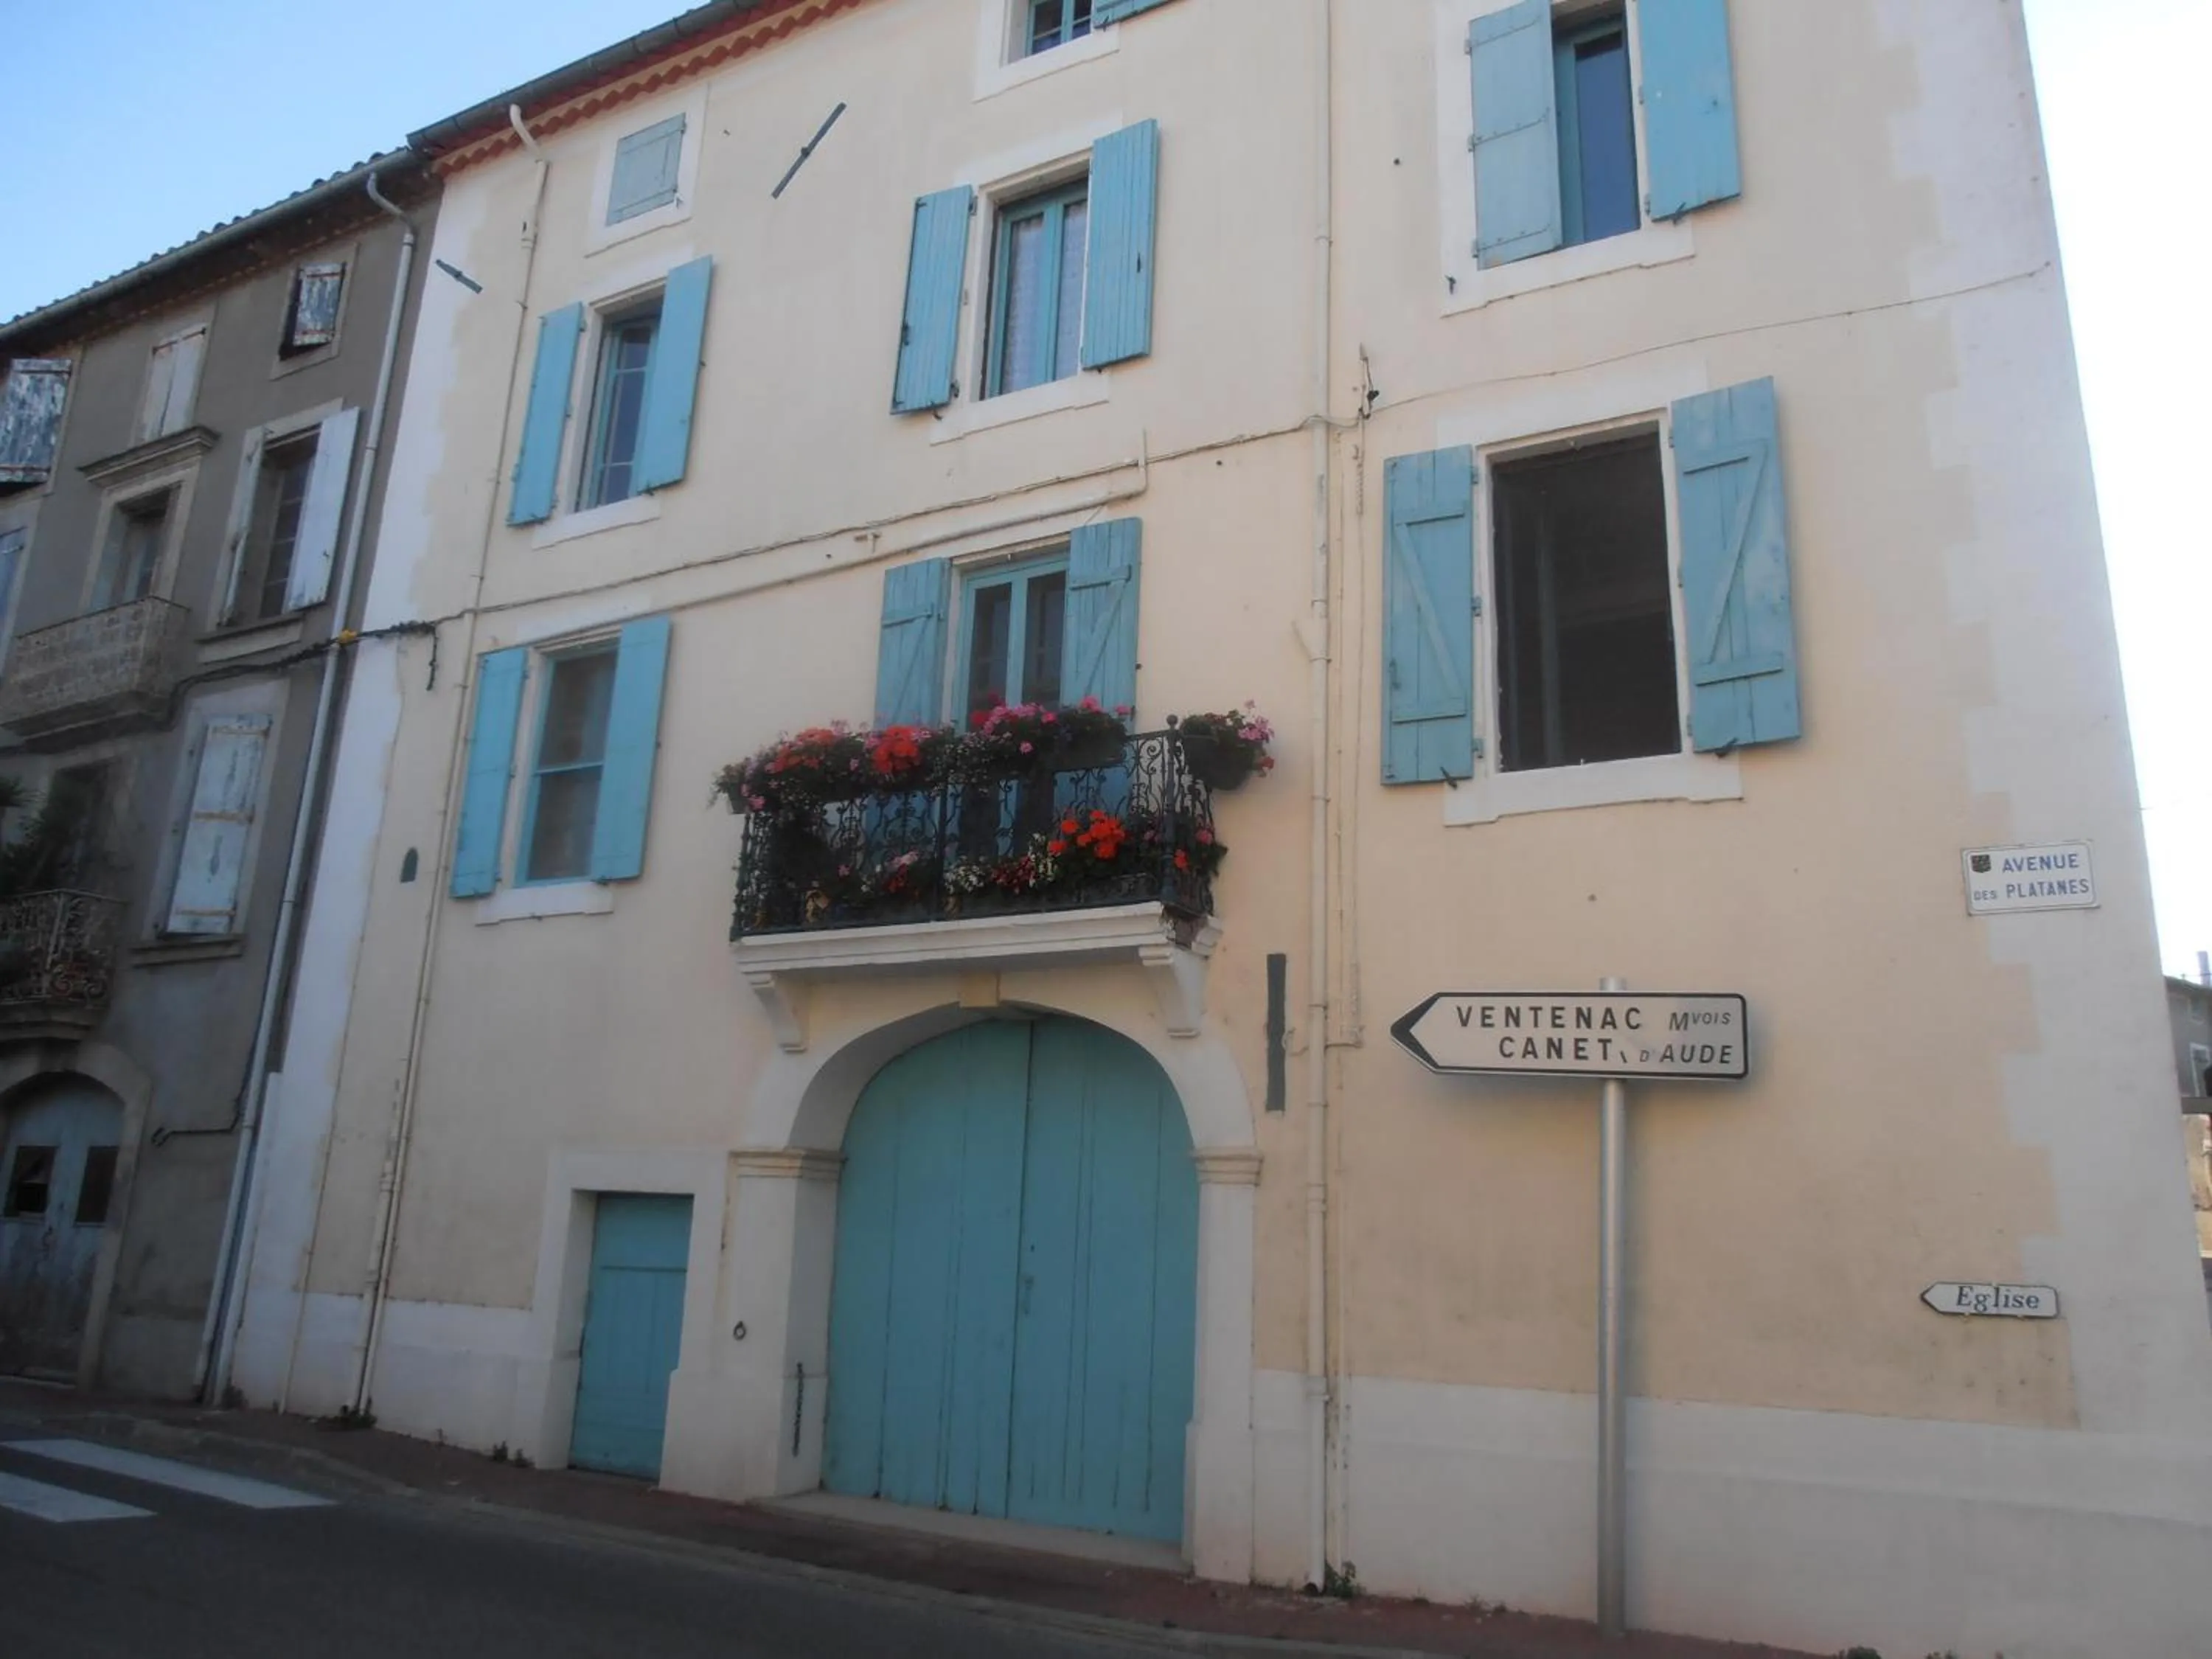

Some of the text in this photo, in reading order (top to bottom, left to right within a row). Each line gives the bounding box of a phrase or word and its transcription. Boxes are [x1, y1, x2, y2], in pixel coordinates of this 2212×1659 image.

[2003, 853, 2079, 872] AVENUE
[1974, 878, 2090, 900] DES PLATANES
[1456, 1006, 1642, 1030] VENTENAC
[1499, 1037, 1612, 1060] CANET
[1956, 1285, 2039, 1312] Eglise
